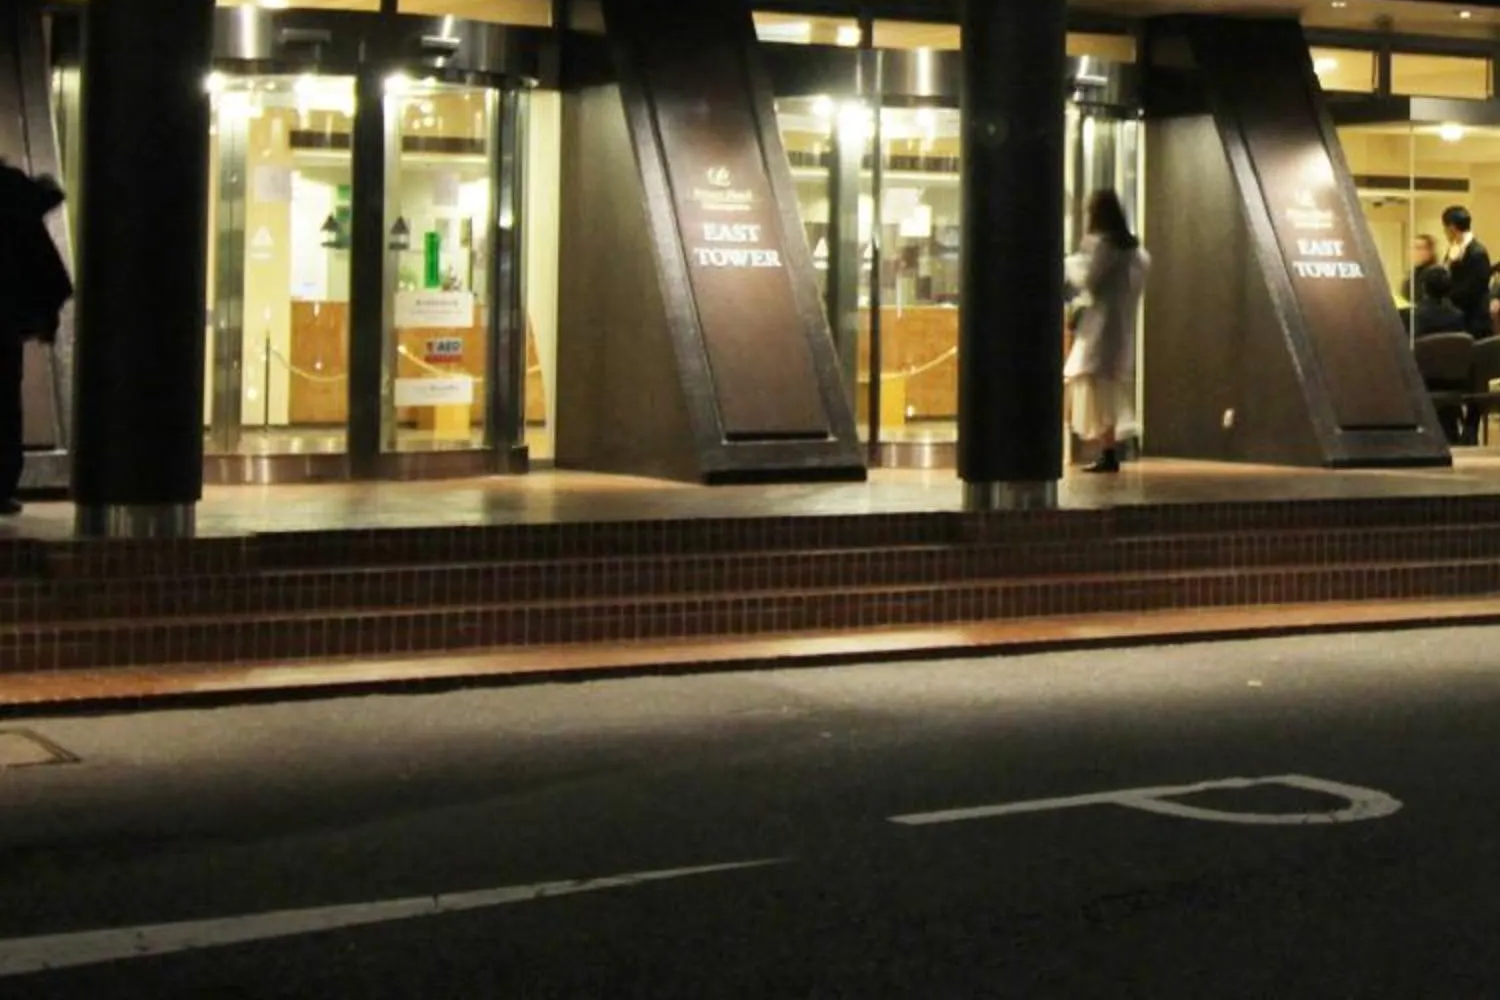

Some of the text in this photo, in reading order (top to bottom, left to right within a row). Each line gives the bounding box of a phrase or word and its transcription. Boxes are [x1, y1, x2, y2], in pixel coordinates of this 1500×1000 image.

[703, 222, 761, 243] EAST
[693, 247, 782, 267] TOWER
[1296, 239, 1344, 257] EAST
[1292, 261, 1365, 279] TOWER
